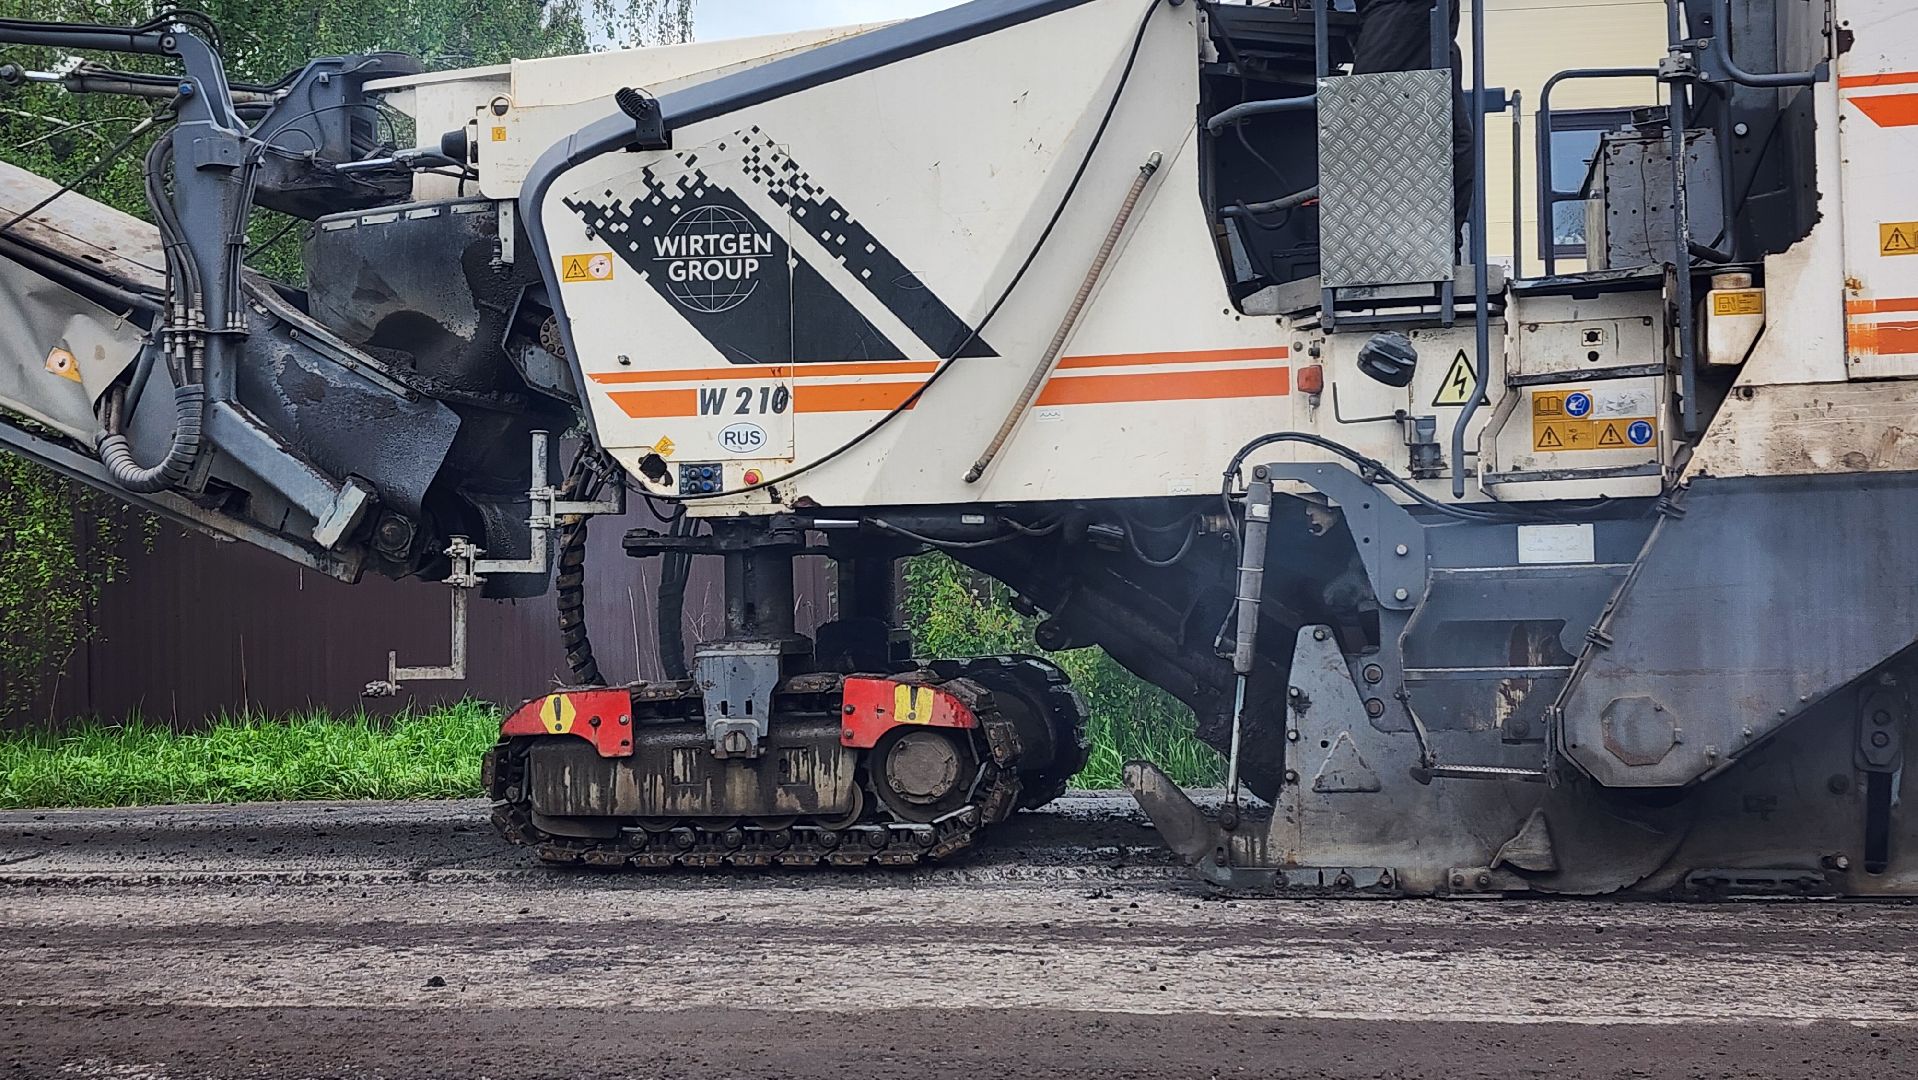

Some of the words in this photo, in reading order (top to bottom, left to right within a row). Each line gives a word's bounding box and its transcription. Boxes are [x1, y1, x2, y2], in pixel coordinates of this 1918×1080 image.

[653, 232, 772, 257] WIRTGEN
[668, 258, 759, 282] GROUP
[700, 387, 728, 416] W
[733, 386, 790, 415] 210
[724, 430, 761, 446] RUS
